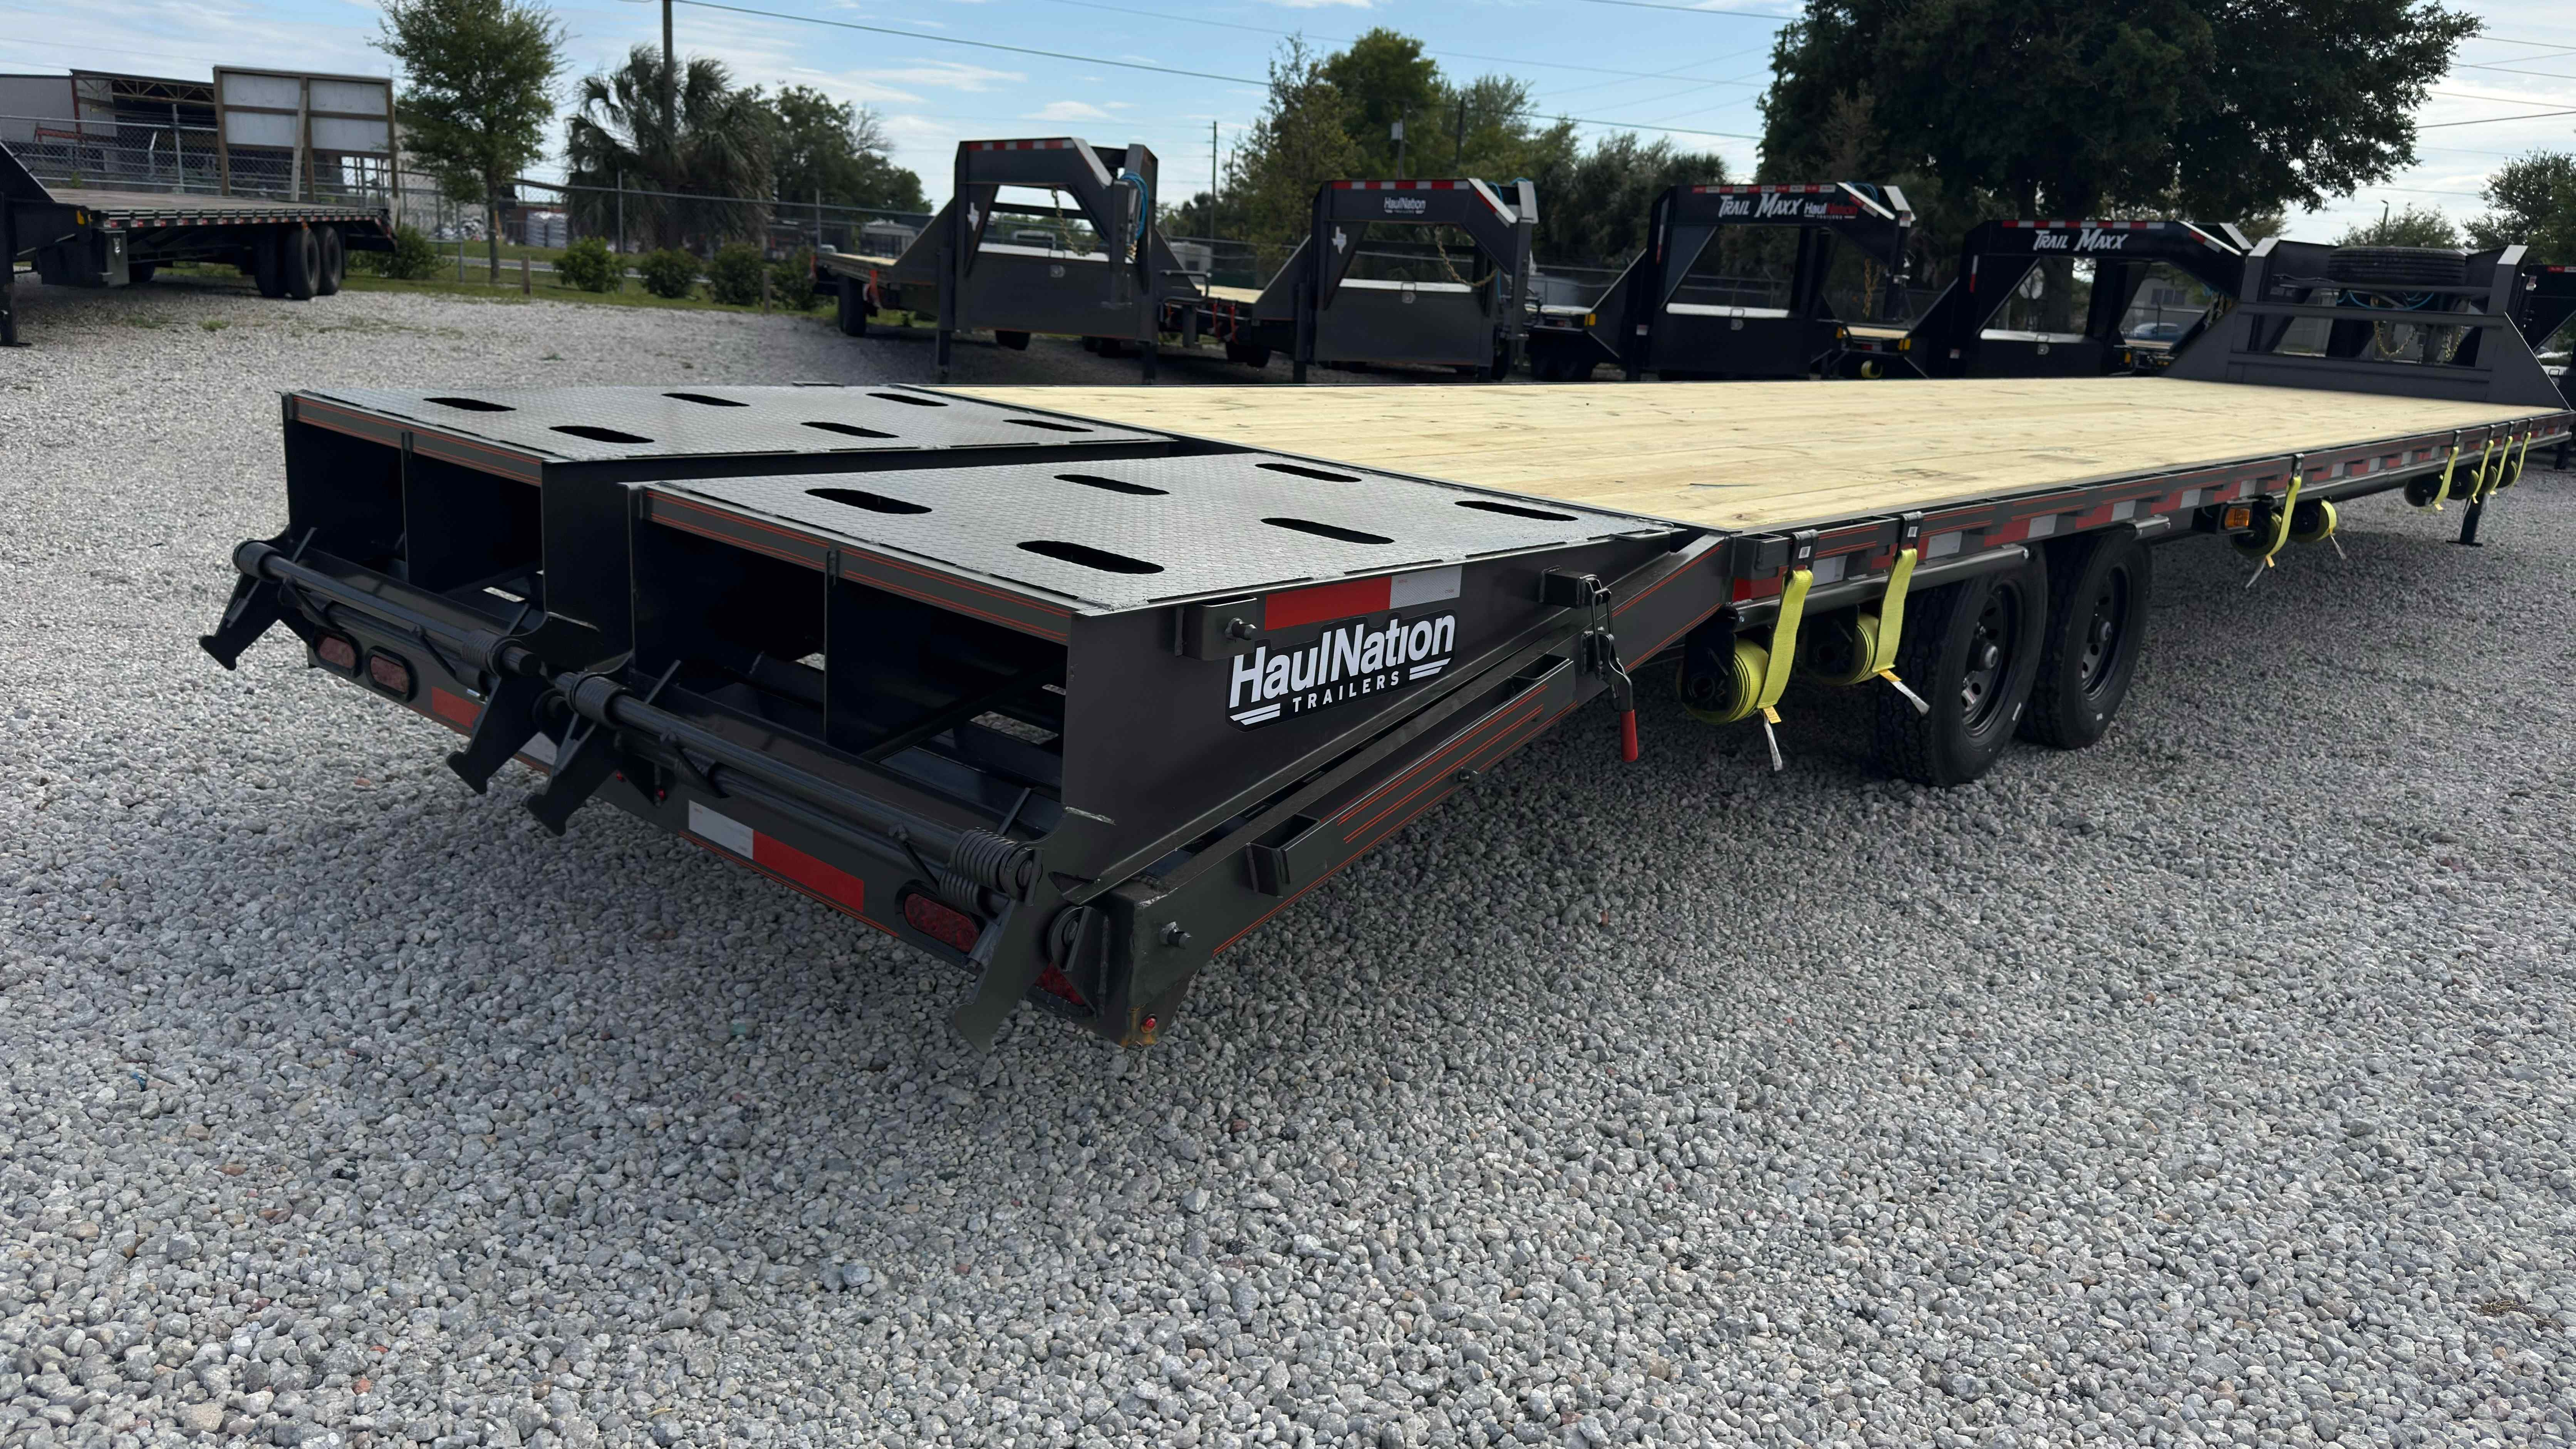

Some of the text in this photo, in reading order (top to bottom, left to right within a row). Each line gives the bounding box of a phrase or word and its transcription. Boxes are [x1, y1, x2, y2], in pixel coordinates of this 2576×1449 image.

[1718, 193, 1804, 218] TRAIL MAXX
[2033, 228, 2129, 251] TRAIL MAXX
[1229, 615, 1455, 708] HaulNation
[1293, 671, 1399, 712] TRAILERS
